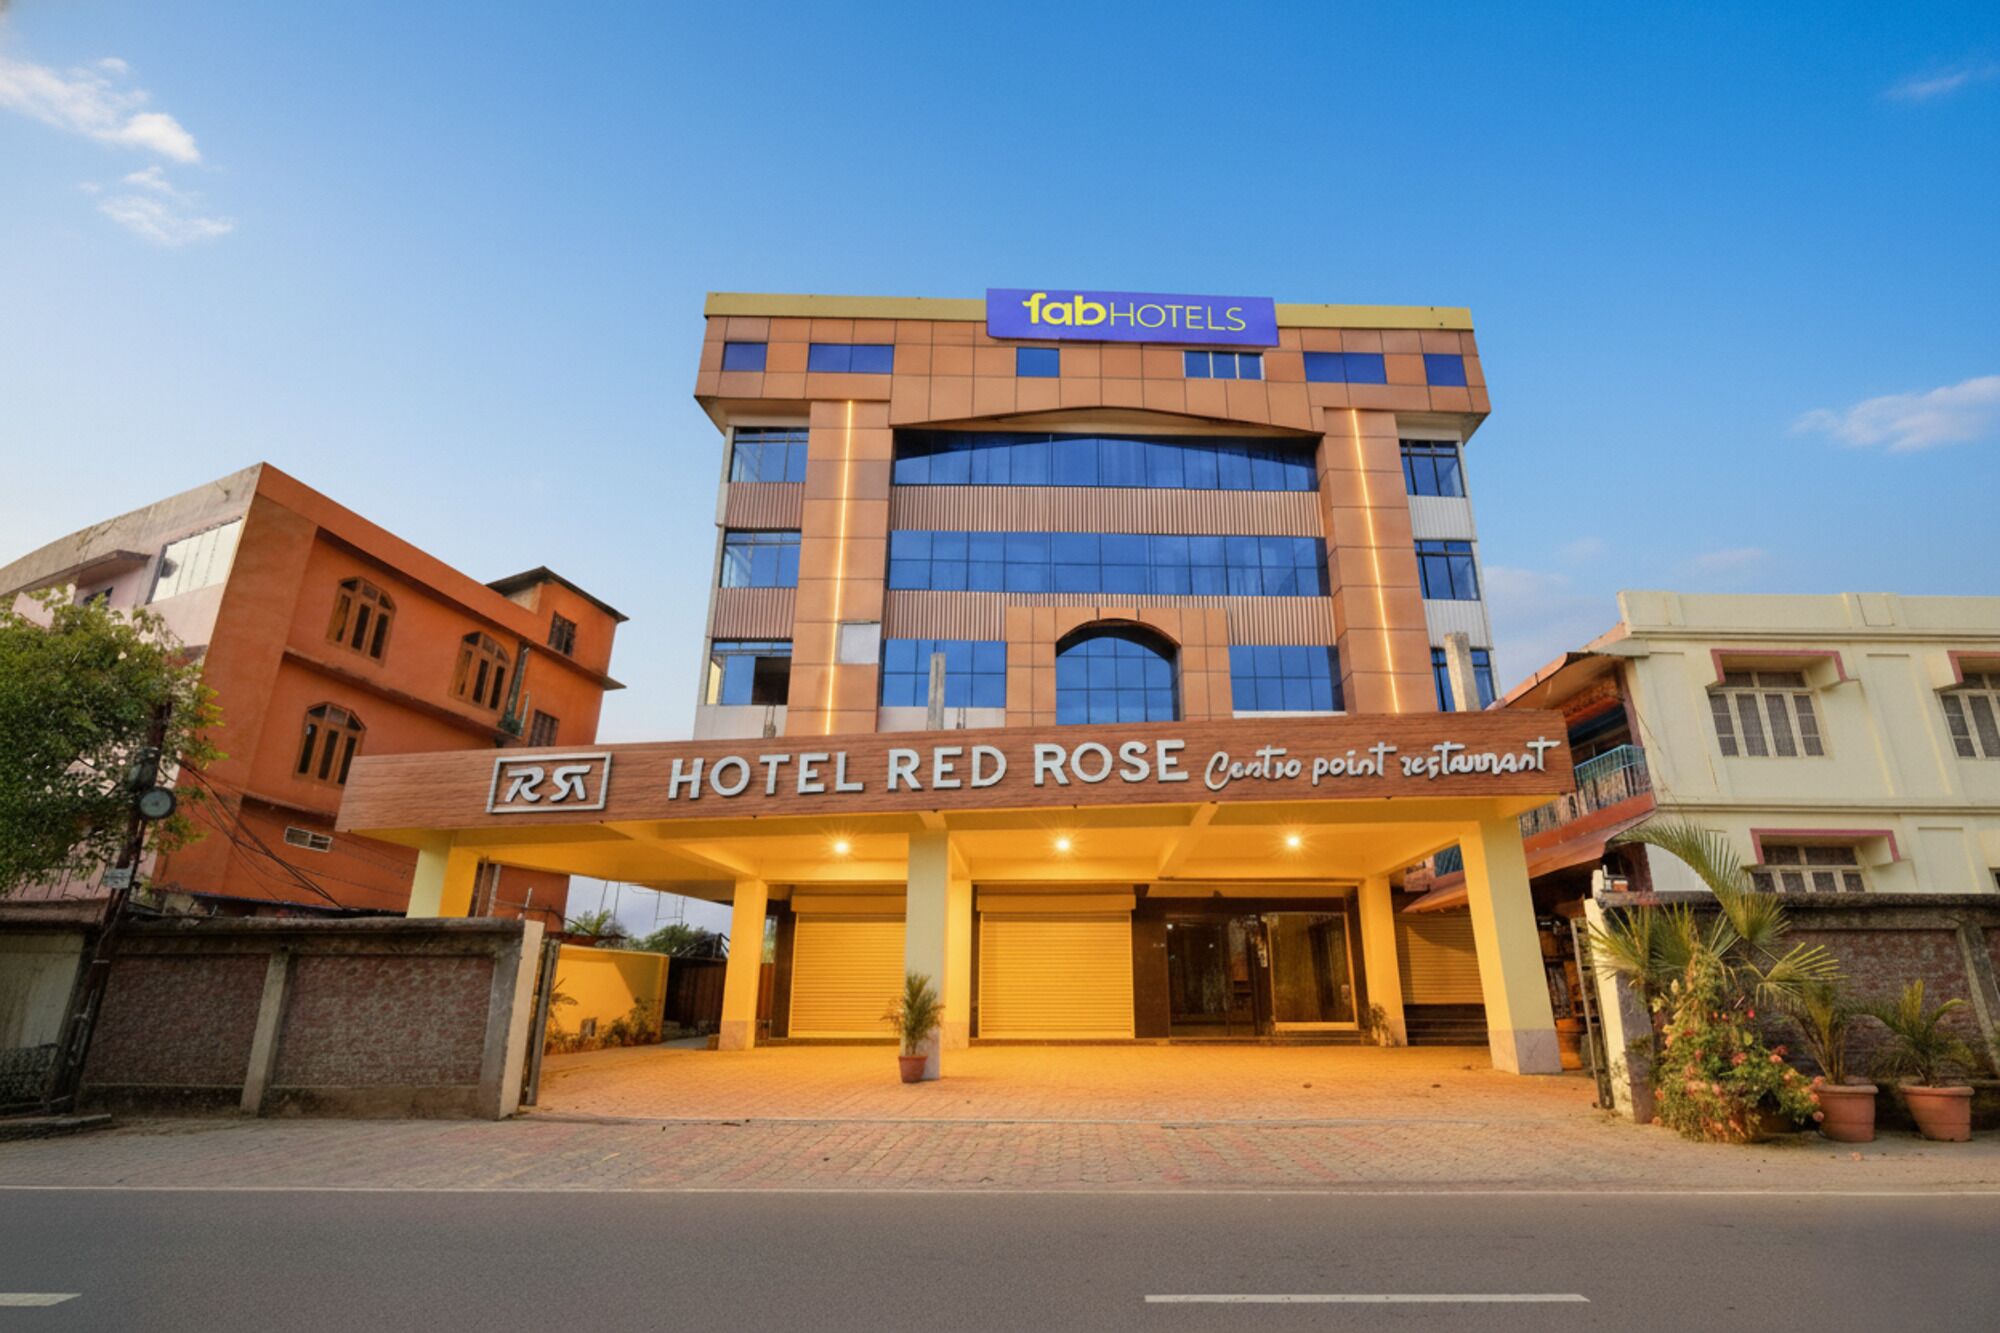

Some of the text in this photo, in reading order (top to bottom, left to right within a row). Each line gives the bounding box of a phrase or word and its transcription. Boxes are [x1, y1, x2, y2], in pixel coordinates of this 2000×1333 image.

[1022, 293, 1247, 332] fabHOTELS
[667, 739, 1189, 800] HOTEL RED ROSE
[1312, 741, 1398, 787] point
[1400, 736, 1562, 779] restaurant
